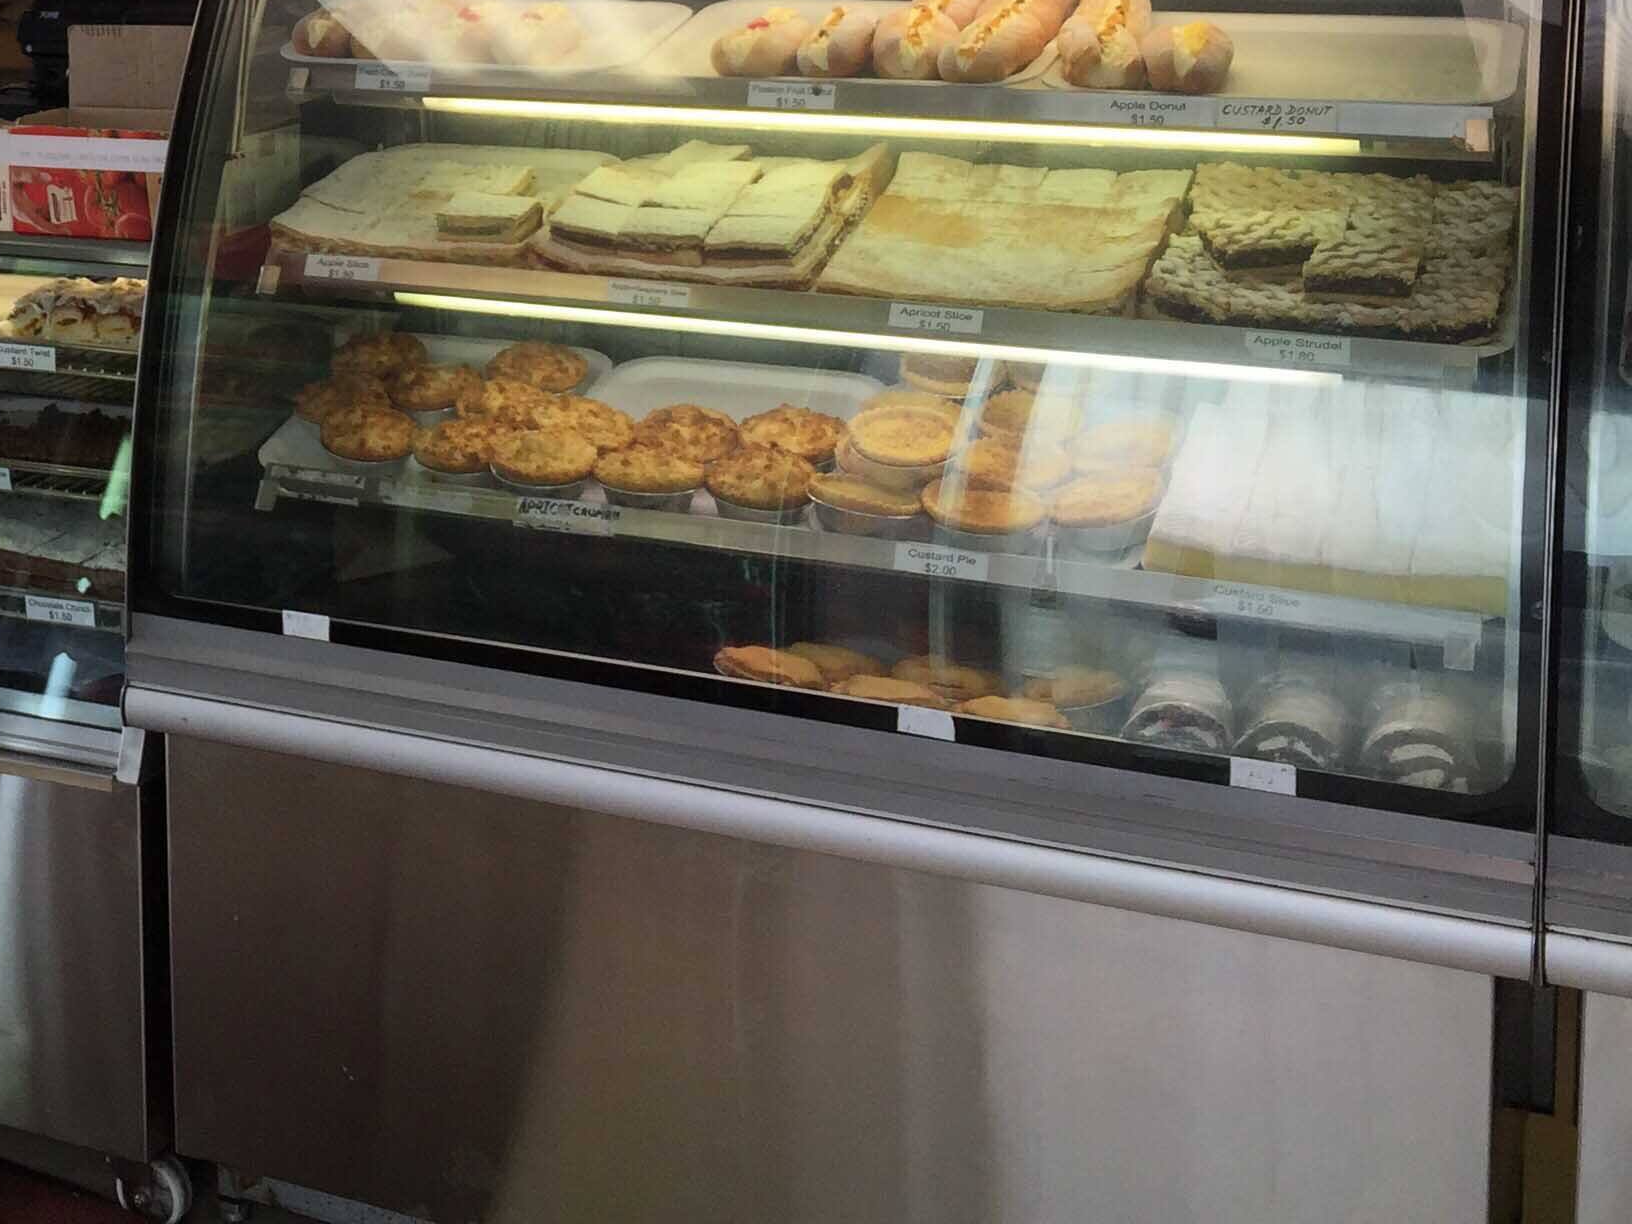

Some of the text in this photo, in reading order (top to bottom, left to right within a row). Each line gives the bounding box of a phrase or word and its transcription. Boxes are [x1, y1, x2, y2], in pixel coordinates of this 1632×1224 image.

[379, 79, 405, 89] $1.50
[776, 96, 806, 108] $1.50
[1110, 100, 1186, 113] Apple Donut
[1221, 103, 1333, 116] CUSTARD DONUT
[1130, 114, 1165, 126] $1.50
[1261, 116, 1306, 129] $1.50
[317, 257, 369, 269] Apple Slice
[900, 306, 974, 321] Apricot Slice
[919, 320, 951, 332] $1.50
[1253, 335, 1343, 351] Apple Strudel
[30, 347, 51, 358] Twist
[908, 548, 977, 566] Custard Pie
[925, 562, 956, 576] $2.00
[1214, 584, 1265, 601] Custard
